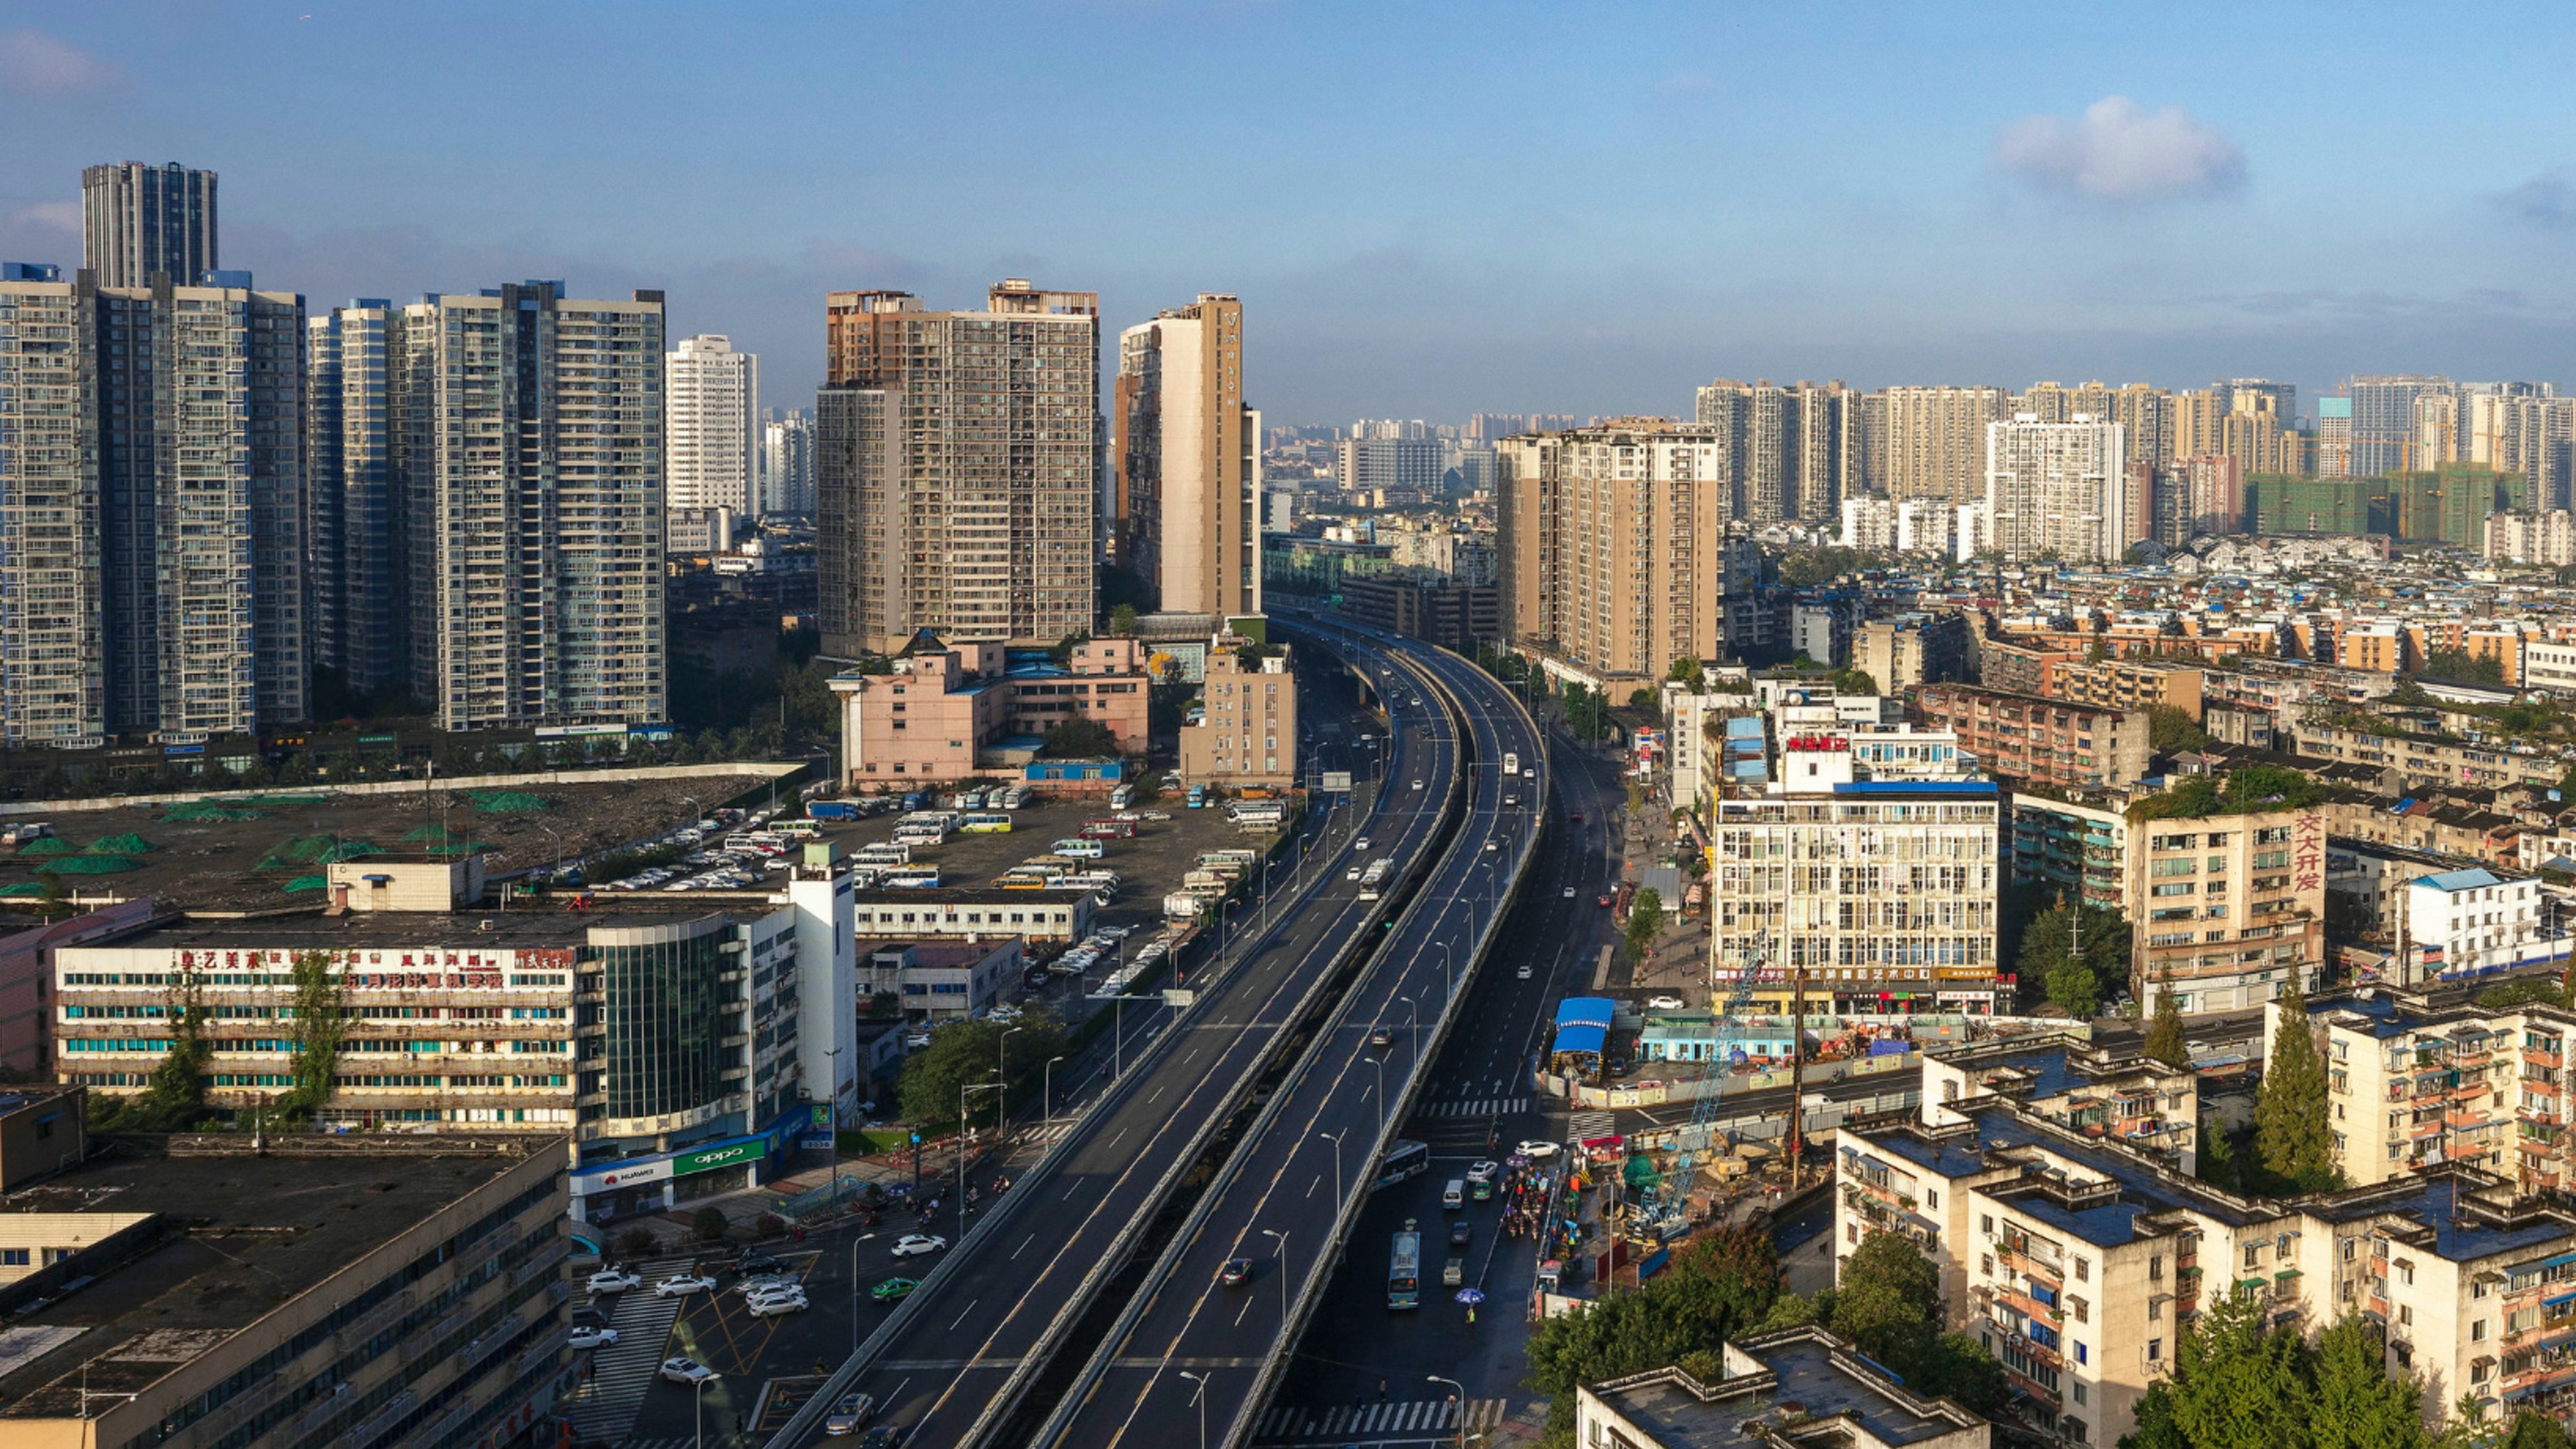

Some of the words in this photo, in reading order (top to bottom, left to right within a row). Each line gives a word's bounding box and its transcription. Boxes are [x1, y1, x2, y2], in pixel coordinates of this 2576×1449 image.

[2294, 814, 2322, 892] 交大开发
[345, 972, 504, 989] 五月花计算机学校
[621, 1169, 653, 1180] HUAWEI
